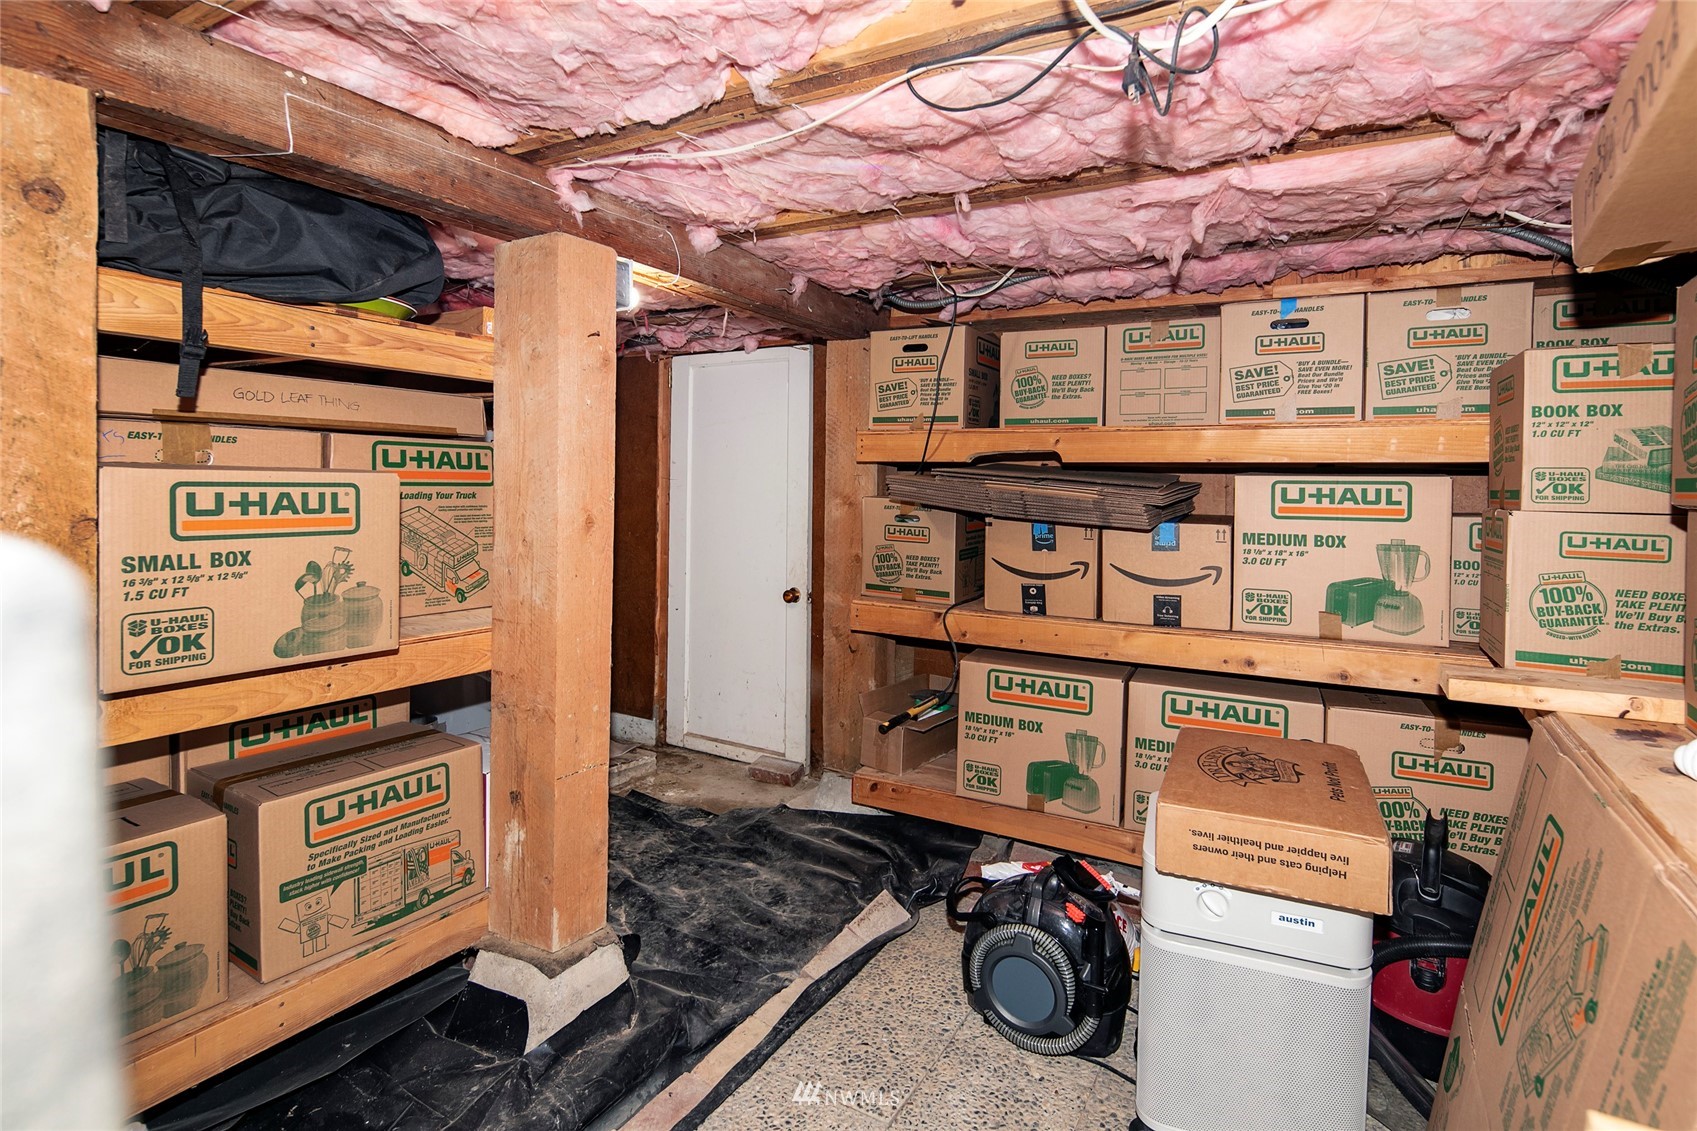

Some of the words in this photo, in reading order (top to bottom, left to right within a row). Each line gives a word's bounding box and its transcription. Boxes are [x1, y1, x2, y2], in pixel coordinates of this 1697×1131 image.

[1413, 328, 1482, 340] U-HAUL
[1029, 342, 1074, 352] U-HAUL
[1260, 336, 1320, 347] U-HAUL
[895, 358, 935, 367] U-HAUL
[1383, 359, 1434, 376] SAVE!
[1563, 357, 1674, 378] U-HU
[1234, 365, 1279, 380] SAVE!
[878, 381, 908, 394] SAVE!
[1016, 375, 1042, 388] 100%
[1236, 382, 1254, 392] BEST
[1256, 379, 1279, 389] PRICE
[1385, 378, 1406, 388] BEST
[1408, 375, 1436, 385] PRICE
[1014, 385, 1046, 397] BUY-BACK
[1236, 387, 1281, 399] GUARANTEED
[1386, 383, 1437, 396] GUARANTEED
[233, 387, 275, 403] GOLD
[281, 392, 313, 404] LEAF
[318, 394, 360, 411] THING
[879, 395, 893, 403] BEST
[893, 393, 908, 401] PRICE
[879, 400, 909, 409] GUARANTEED
[1531, 405, 1580, 418] BOOK
[1586, 404, 1623, 417] BOX
[1531, 430, 1547, 438] 1.0
[1550, 430, 1566, 438] CU
[1567, 429, 1581, 437] FT
[382, 448, 489, 470] U-HAUL
[1552, 483, 1585, 495] OK
[400, 491, 433, 501] Loading
[456, 491, 477, 499] Truck
[1281, 487, 1403, 506] U-HAUL
[186, 492, 350, 517] U-HAUL
[887, 527, 927, 537] U-HAUL
[1242, 532, 1307, 547] MEDIUM
[1314, 534, 1346, 548] BOX
[1567, 536, 1664, 552] U-HAUL
[121, 553, 201, 574] SMALL
[210, 550, 252, 568] BOX
[1242, 557, 1257, 565] 3.0
[1274, 558, 1287, 566] FT
[122, 579, 136, 587] 16
[172, 576, 184, 584] 12
[217, 572, 229, 580] 12
[1542, 573, 1582, 581] U-HAUL
[123, 591, 144, 602] 1.5
[149, 589, 168, 599] CU
[172, 587, 189, 598] FT
[1539, 585, 1594, 604] 100%
[1615, 589, 1648, 599] NEED
[1259, 604, 1287, 616] OK
[1536, 603, 1602, 618] BUY-BACK
[1615, 600, 1645, 610] TAKE
[151, 613, 208, 626] U-HAUL
[1615, 610, 1645, 620] We'll
[1648, 612, 1672, 624] Buy
[151, 622, 208, 635] BOXES
[1614, 621, 1634, 630] the
[1637, 623, 1681, 634] Extras.
[157, 633, 206, 655] OK
[129, 661, 151, 670] FOR
[155, 653, 207, 667] SHIPPING
[994, 674, 1086, 702] U-HAUL
[1170, 697, 1280, 727] U-HAUL
[241, 703, 369, 747] U-HAUL
[965, 711, 1014, 729] MEDIUM
[1018, 719, 1043, 734] BOX
[964, 732, 976, 740] 3.0
[977, 734, 987, 742] CU
[988, 735, 998, 744] FT
[1399, 756, 1487, 779] U-HAUL
[977, 775, 998, 788] OK
[316, 773, 442, 826] U-HAUL
[308, 838, 358, 862] Specifically
[360, 831, 382, 844] Sized
[383, 826, 398, 838] and
[400, 808, 451, 834] Manufactured
[1189, 829, 1214, 841] lives.
[1217, 833, 1262, 850] healthier
[1470, 834, 1491, 846] Buy
[307, 862, 316, 871] to
[318, 855, 342, 869] Make
[344, 843, 376, 860] Packing
[378, 836, 393, 848] and
[395, 827, 424, 843] Loading
[429, 838, 452, 850] U-HAUL
[1192, 843, 1229, 856] owners
[1265, 841, 1284, 852] and
[1460, 843, 1499, 857] Extras.
[1231, 850, 1255, 862] their
[1257, 855, 1277, 865] and
[1286, 845, 1327, 862] happier
[1330, 853, 1349, 866] live
[1279, 859, 1302, 869] cats
[1305, 862, 1347, 880] Helping
[1278, 914, 1315, 928] austin
[1497, 837, 1555, 1017] U-HAUL
